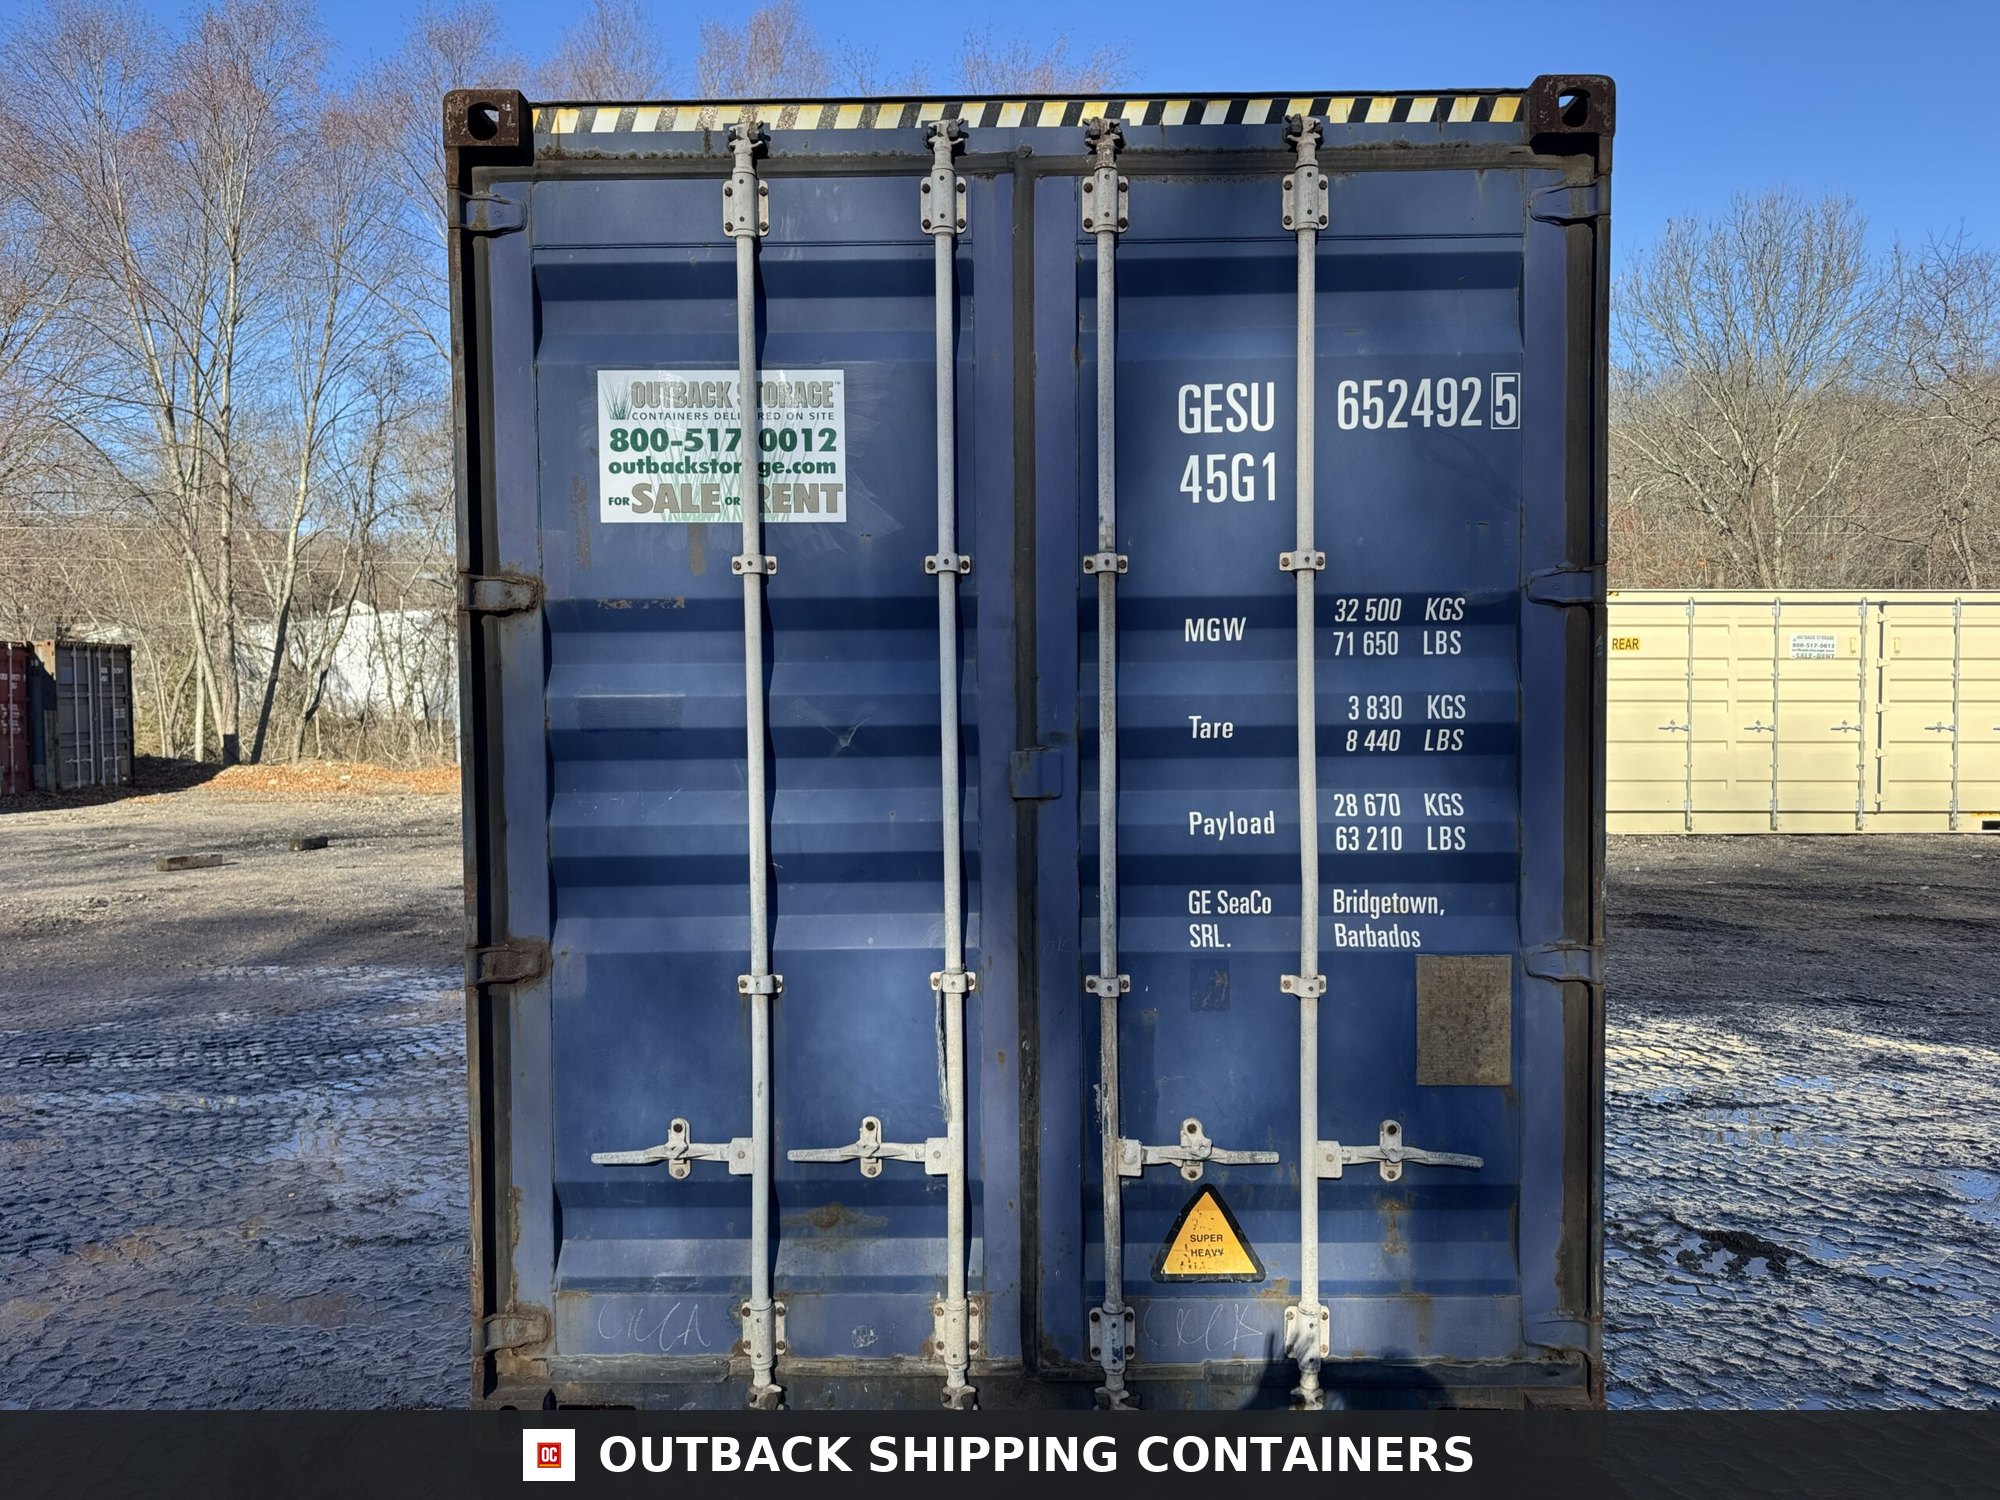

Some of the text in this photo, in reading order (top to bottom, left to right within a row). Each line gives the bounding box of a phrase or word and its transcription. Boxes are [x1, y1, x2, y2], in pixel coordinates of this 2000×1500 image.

[631, 381, 733, 408] OUTBACK
[737, 381, 834, 408] TORAGE
[632, 412, 834, 420] CONTAINERS DELIRED ON SITE
[1178, 382, 1275, 434] GESU
[609, 428, 837, 452] 800-5170012
[608, 456, 836, 477] outbackstorge.com
[1179, 452, 1276, 503] 45G1
[608, 496, 630, 505] FOR
[631, 483, 720, 513] SALE
[724, 496, 741, 505] OR
[1334, 598, 1466, 622] 32 500 KGS
[1184, 617, 1247, 642] MGW
[1332, 630, 1462, 656] 71 650 LBS
[1612, 638, 1639, 650] REAR
[1348, 695, 1466, 720] 3 830 KGS
[1188, 715, 1234, 739] Tare
[1345, 729, 1465, 751] 8 440 LBS
[1333, 793, 1465, 817] 28 670 KGS
[1188, 810, 1276, 841] Payload
[1335, 826, 1466, 851] 63 210 LBS
[1188, 889, 1272, 915] GE SeaCo
[1333, 889, 1445, 919] Bridgetown,
[1189, 924, 1232, 948] SRL.
[1334, 923, 1422, 948] Barbados
[1190, 1234, 1224, 1242] SUPER
[1190, 1248, 1224, 1257] HEAVY
